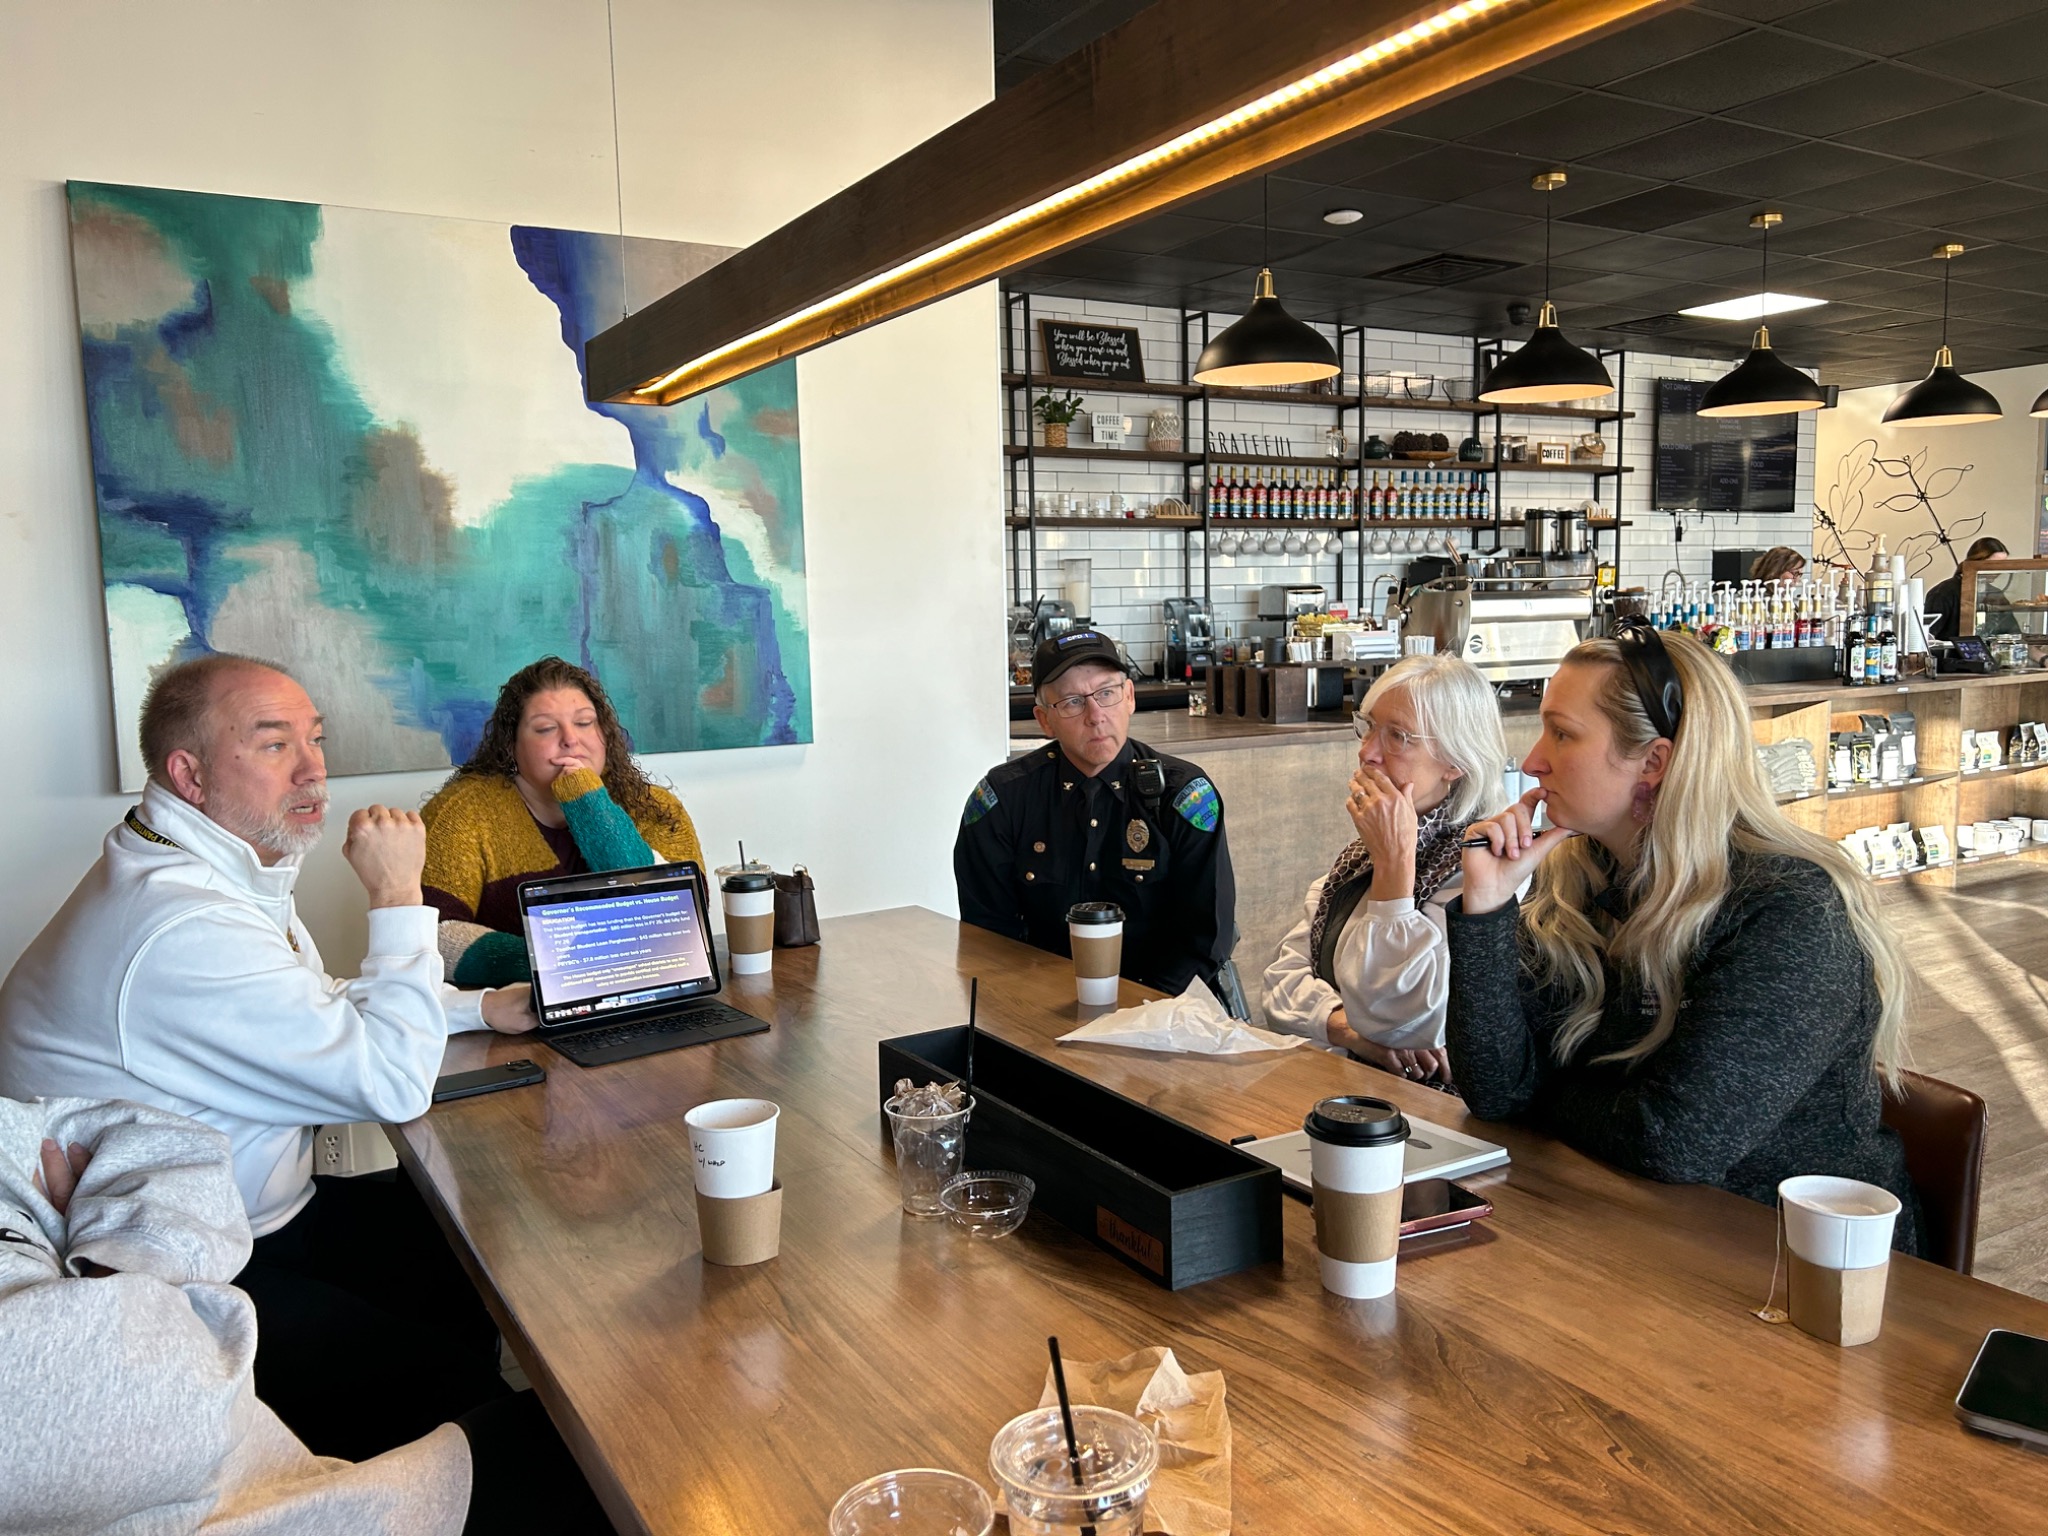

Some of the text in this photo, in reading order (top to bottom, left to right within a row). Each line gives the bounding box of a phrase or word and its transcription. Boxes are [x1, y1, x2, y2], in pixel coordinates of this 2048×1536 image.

[1053, 328, 1126, 346] You will be Blessed
[1054, 339, 1128, 357] when you come in and
[1057, 351, 1131, 371] Blessed when you go out
[1662, 383, 1692, 392] HOT DRINKS
[1096, 415, 1120, 425] COFFEE
[1101, 431, 1118, 441] TIME
[1208, 431, 1293, 458] GRATEFUL
[1542, 449, 1565, 459] COFFEE
[1066, 634, 1083, 642] CPD
[541, 906, 575, 916] Governor's
[575, 902, 615, 912] Recommended
[616, 899, 635, 908] Budget
[541, 916, 576, 925] EDUCATION
[1108, 1218, 1153, 1261] thankful
